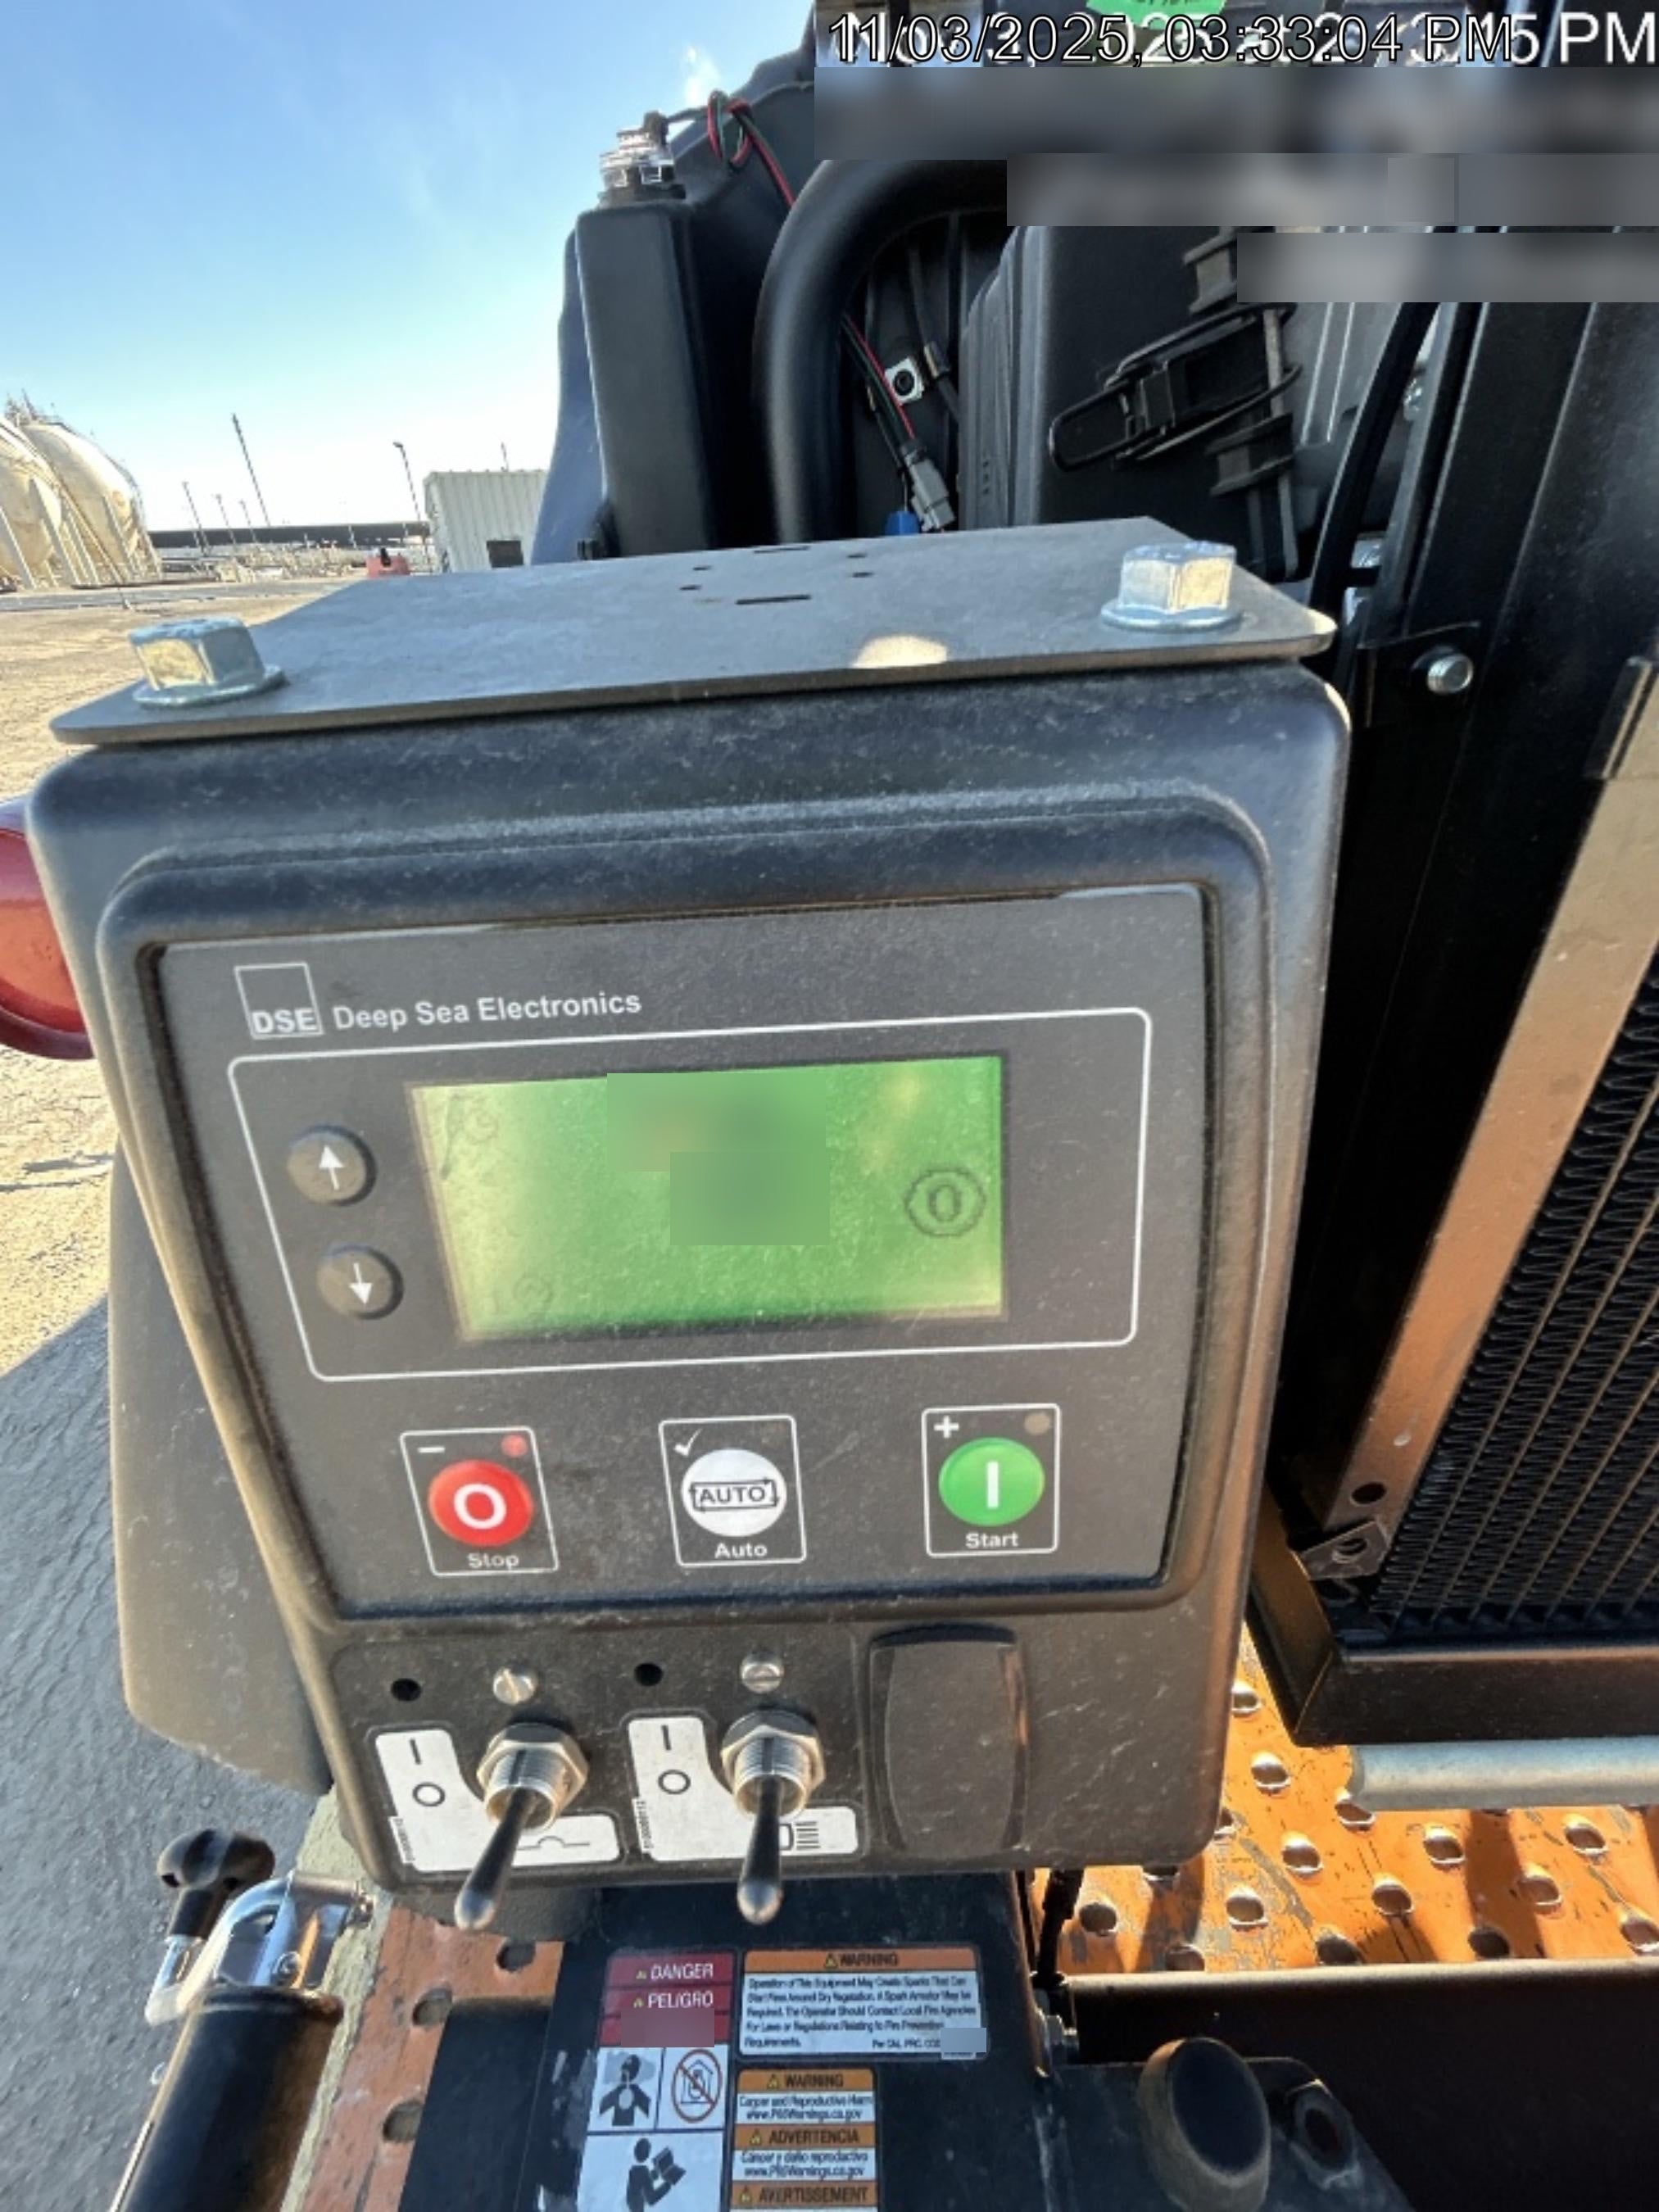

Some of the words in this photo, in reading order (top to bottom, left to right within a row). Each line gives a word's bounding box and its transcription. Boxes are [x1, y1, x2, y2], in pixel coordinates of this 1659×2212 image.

[333, 1005, 407, 1032] Deep
[415, 1000, 470, 1026] Sea
[477, 990, 642, 1022] Electronics
[252, 1007, 320, 1034] DSE
[700, 1486, 765, 1504] AUTO
[965, 1531, 1018, 1549] Start
[714, 1543, 768, 1558] Auto
[467, 1552, 519, 1571] Stop
[839, 1952, 898, 1966] WARNING
[650, 1963, 714, 1980] DANGER
[647, 1991, 714, 2008] PELIGRO
[786, 2074, 844, 2088] WARNING
[768, 2129, 859, 2144] ADVERTENCIA
[759, 2186, 868, 2202] AVERTISSEMENT
